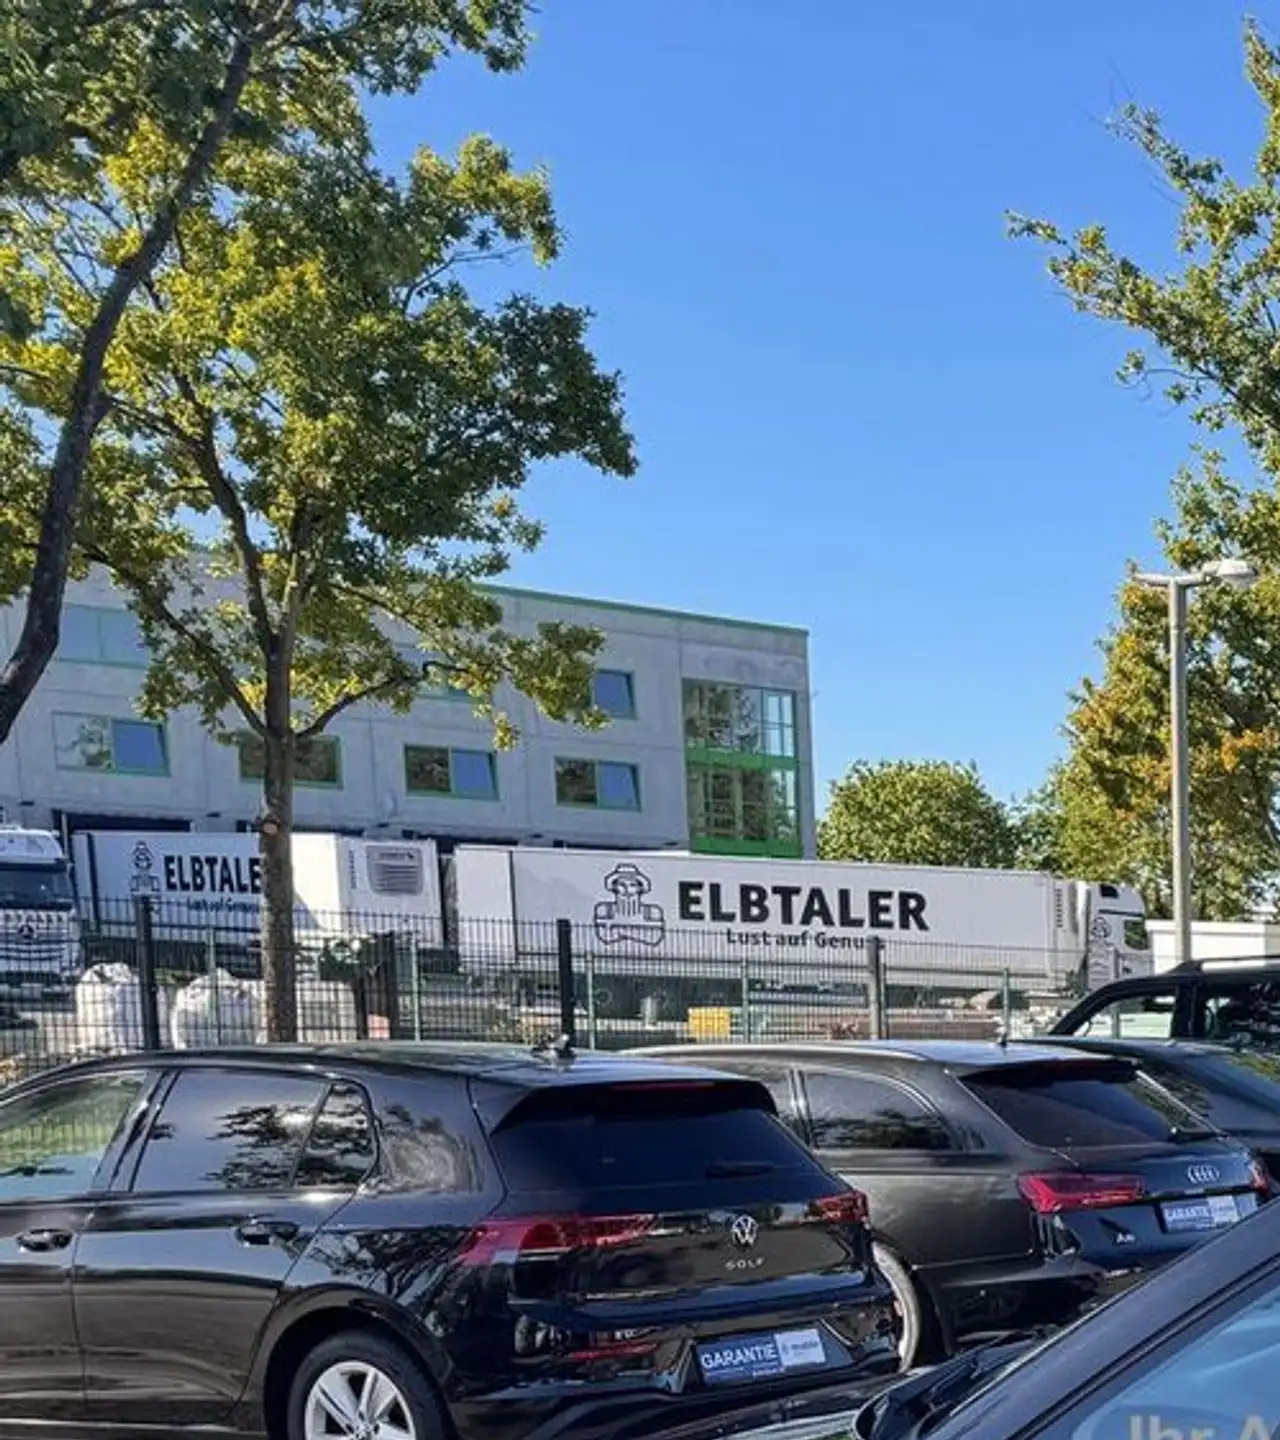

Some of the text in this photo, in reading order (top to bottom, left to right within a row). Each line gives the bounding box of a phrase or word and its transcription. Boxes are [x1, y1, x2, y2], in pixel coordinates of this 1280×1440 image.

[164, 855, 262, 894] ELBTALE
[678, 881, 929, 931] ELBTALER
[726, 928, 886, 949] Lust auf Genu
[701, 1344, 778, 1369] GARANTIE
